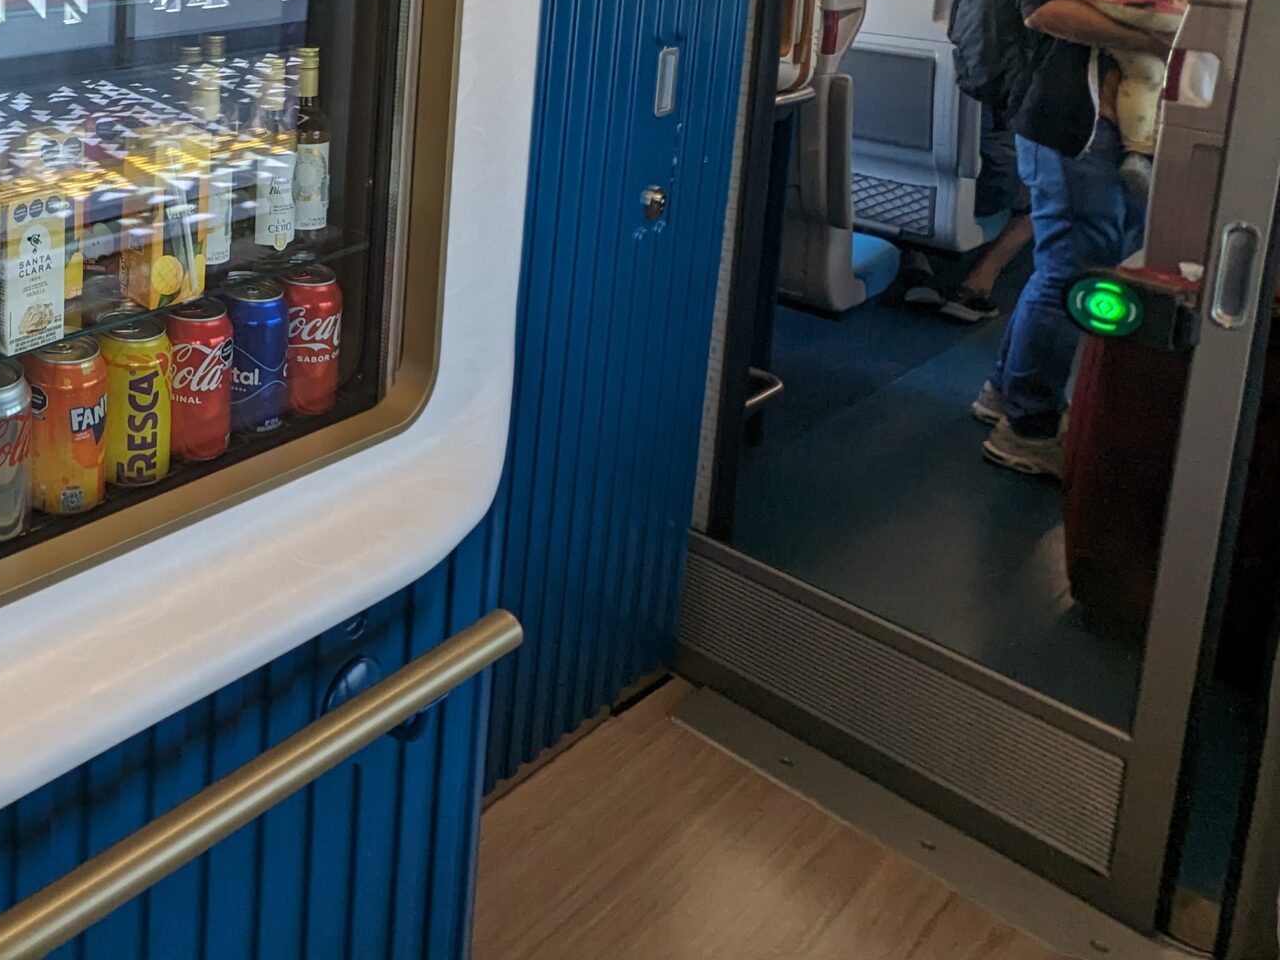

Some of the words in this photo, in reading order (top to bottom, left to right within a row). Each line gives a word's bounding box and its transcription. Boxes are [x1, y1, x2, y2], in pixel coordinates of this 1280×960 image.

[19, 254, 52, 269] SANTA
[18, 264, 52, 279] CLARA
[296, 354, 330, 364] SABOR
[116, 370, 159, 483] FRESCA
